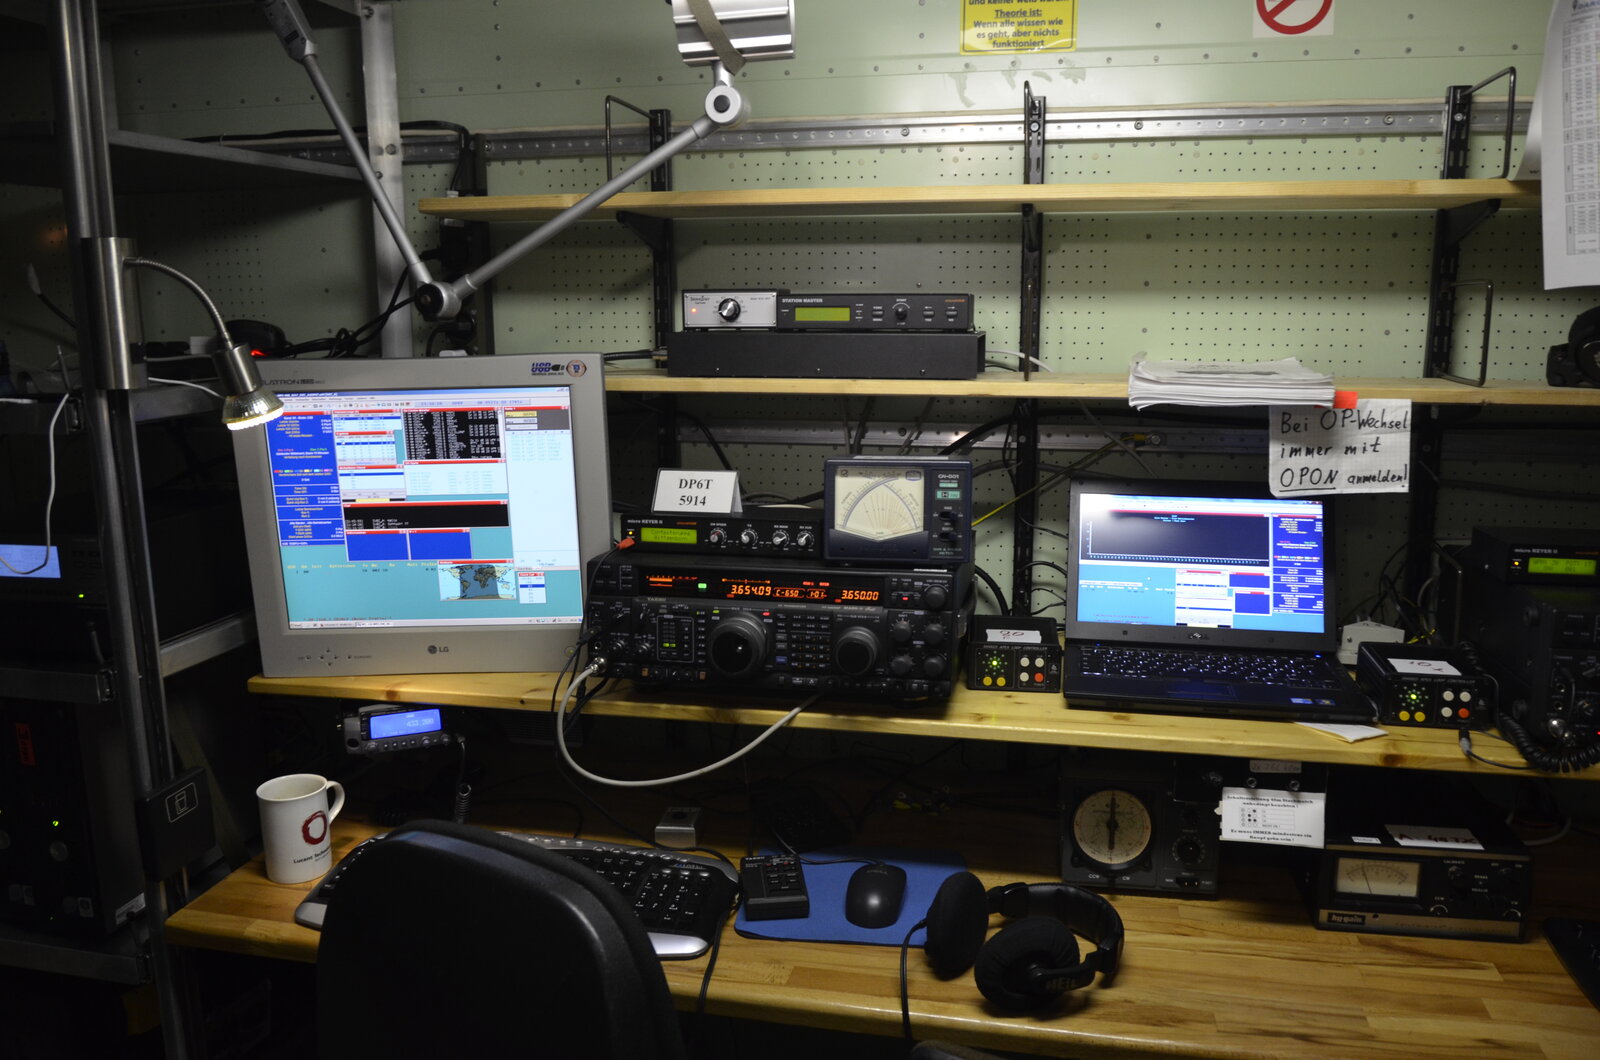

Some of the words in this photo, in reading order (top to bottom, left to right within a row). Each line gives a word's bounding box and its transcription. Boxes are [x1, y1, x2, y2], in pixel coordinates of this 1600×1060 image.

[995, 9, 1027, 17] Theorie
[1029, 9, 1042, 17] ist:
[973, 20, 998, 28] Wenn
[1000, 19, 1015, 27] alle
[1017, 19, 1046, 27] wissen
[1048, 17, 1063, 25] wie
[988, 30, 1010, 41] geht,
[1012, 29, 1031, 37] aber
[1033, 28, 1059, 37] nichts
[992, 39, 1045, 48] funktioniert
[1281, 412, 1308, 433] Bei
[1320, 408, 1408, 430] OP-Wechsel
[1280, 443, 1333, 458] immer
[1344, 436, 1381, 454] mit
[1280, 466, 1338, 487] OPON
[1347, 463, 1408, 488] anmelden!
[679, 479, 713, 489] DP6T
[678, 495, 707, 506] 5914
[293, 856, 313, 864] Lucent
